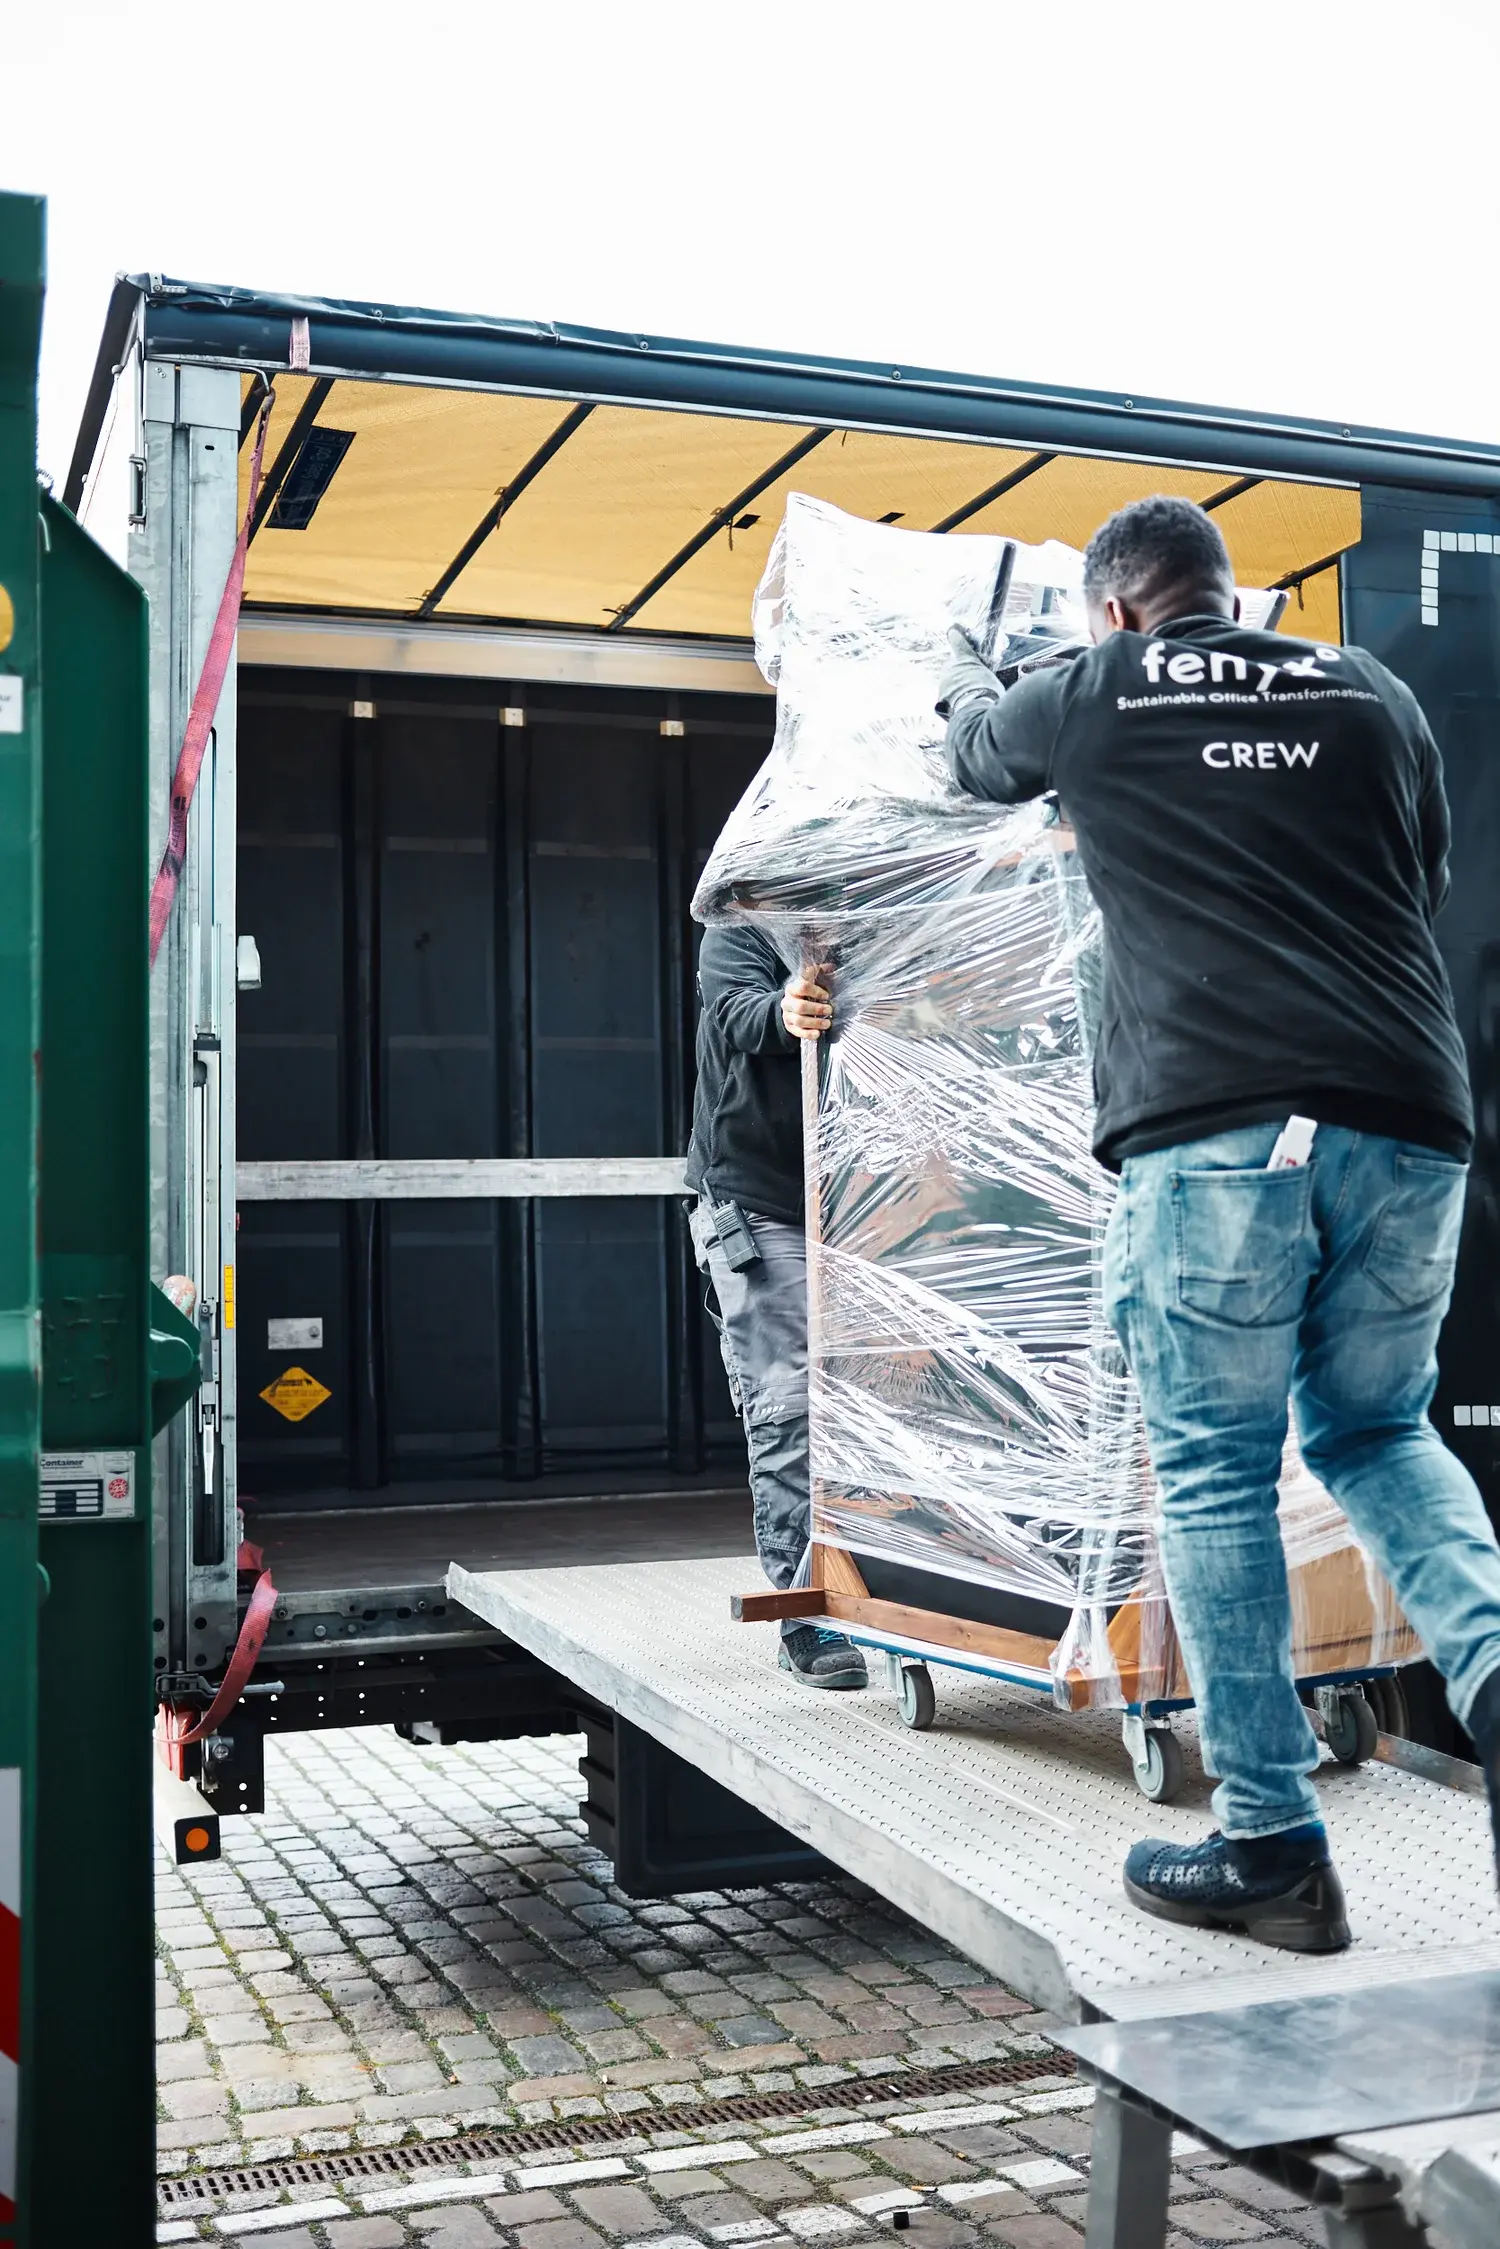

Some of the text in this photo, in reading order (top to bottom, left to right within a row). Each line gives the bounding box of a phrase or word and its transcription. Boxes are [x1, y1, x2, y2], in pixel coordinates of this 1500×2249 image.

[1117, 691, 1206, 711] Sustainable
[1208, 691, 1259, 704] Office
[1202, 742, 1319, 769] CREW
